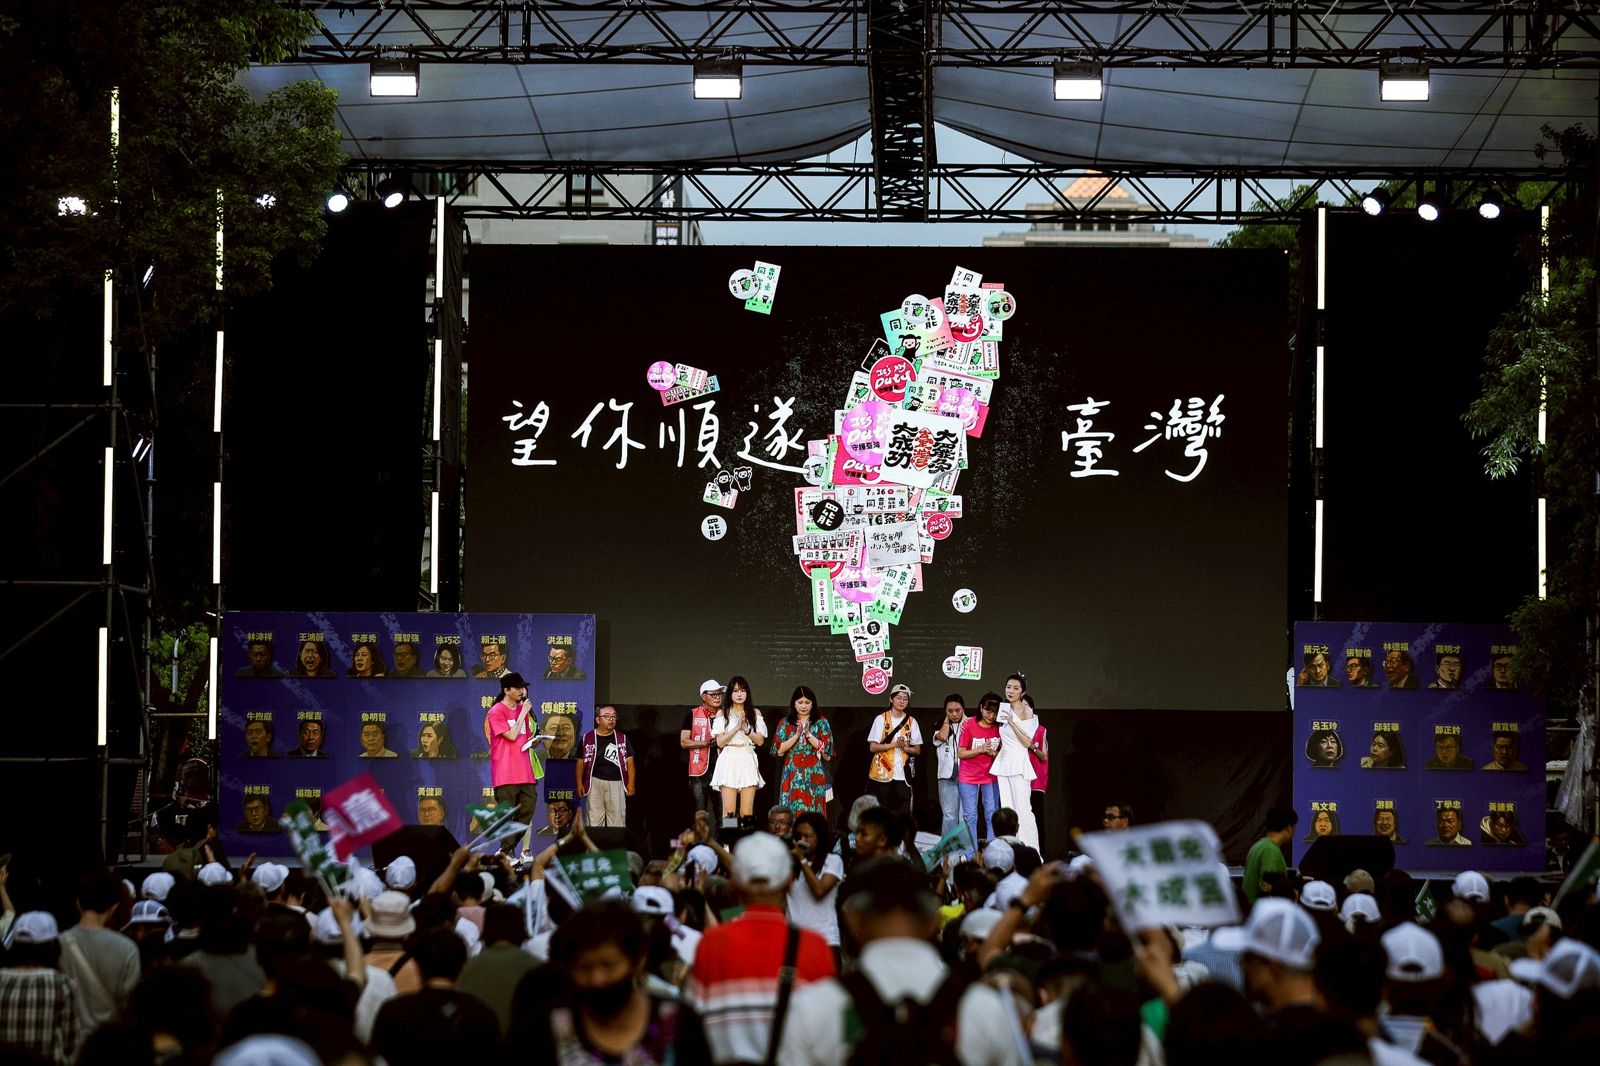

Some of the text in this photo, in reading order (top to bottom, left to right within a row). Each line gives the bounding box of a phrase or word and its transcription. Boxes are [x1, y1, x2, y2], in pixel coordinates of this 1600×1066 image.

[945, 291, 960, 315] 大成功
[502, 395, 1226, 483] 望你順遂 臺灣
[851, 441, 881, 451] 守護臺灣
[884, 422, 918, 470] 大成功
[912, 430, 934, 468] 臺灣
[928, 429, 959, 475] 大罷免
[866, 497, 905, 510] 同意罷免
[816, 502, 839, 527] 罷
[707, 518, 721, 538] 罷
[840, 580, 868, 589] 守護臺灣
[887, 568, 908, 586] 同意
[435, 635, 460, 644] 徐巧芯
[1312, 721, 1337, 730] 呂玉玲
[1311, 802, 1336, 811] 馬文君
[1435, 800, 1460, 809] 丁學忠
